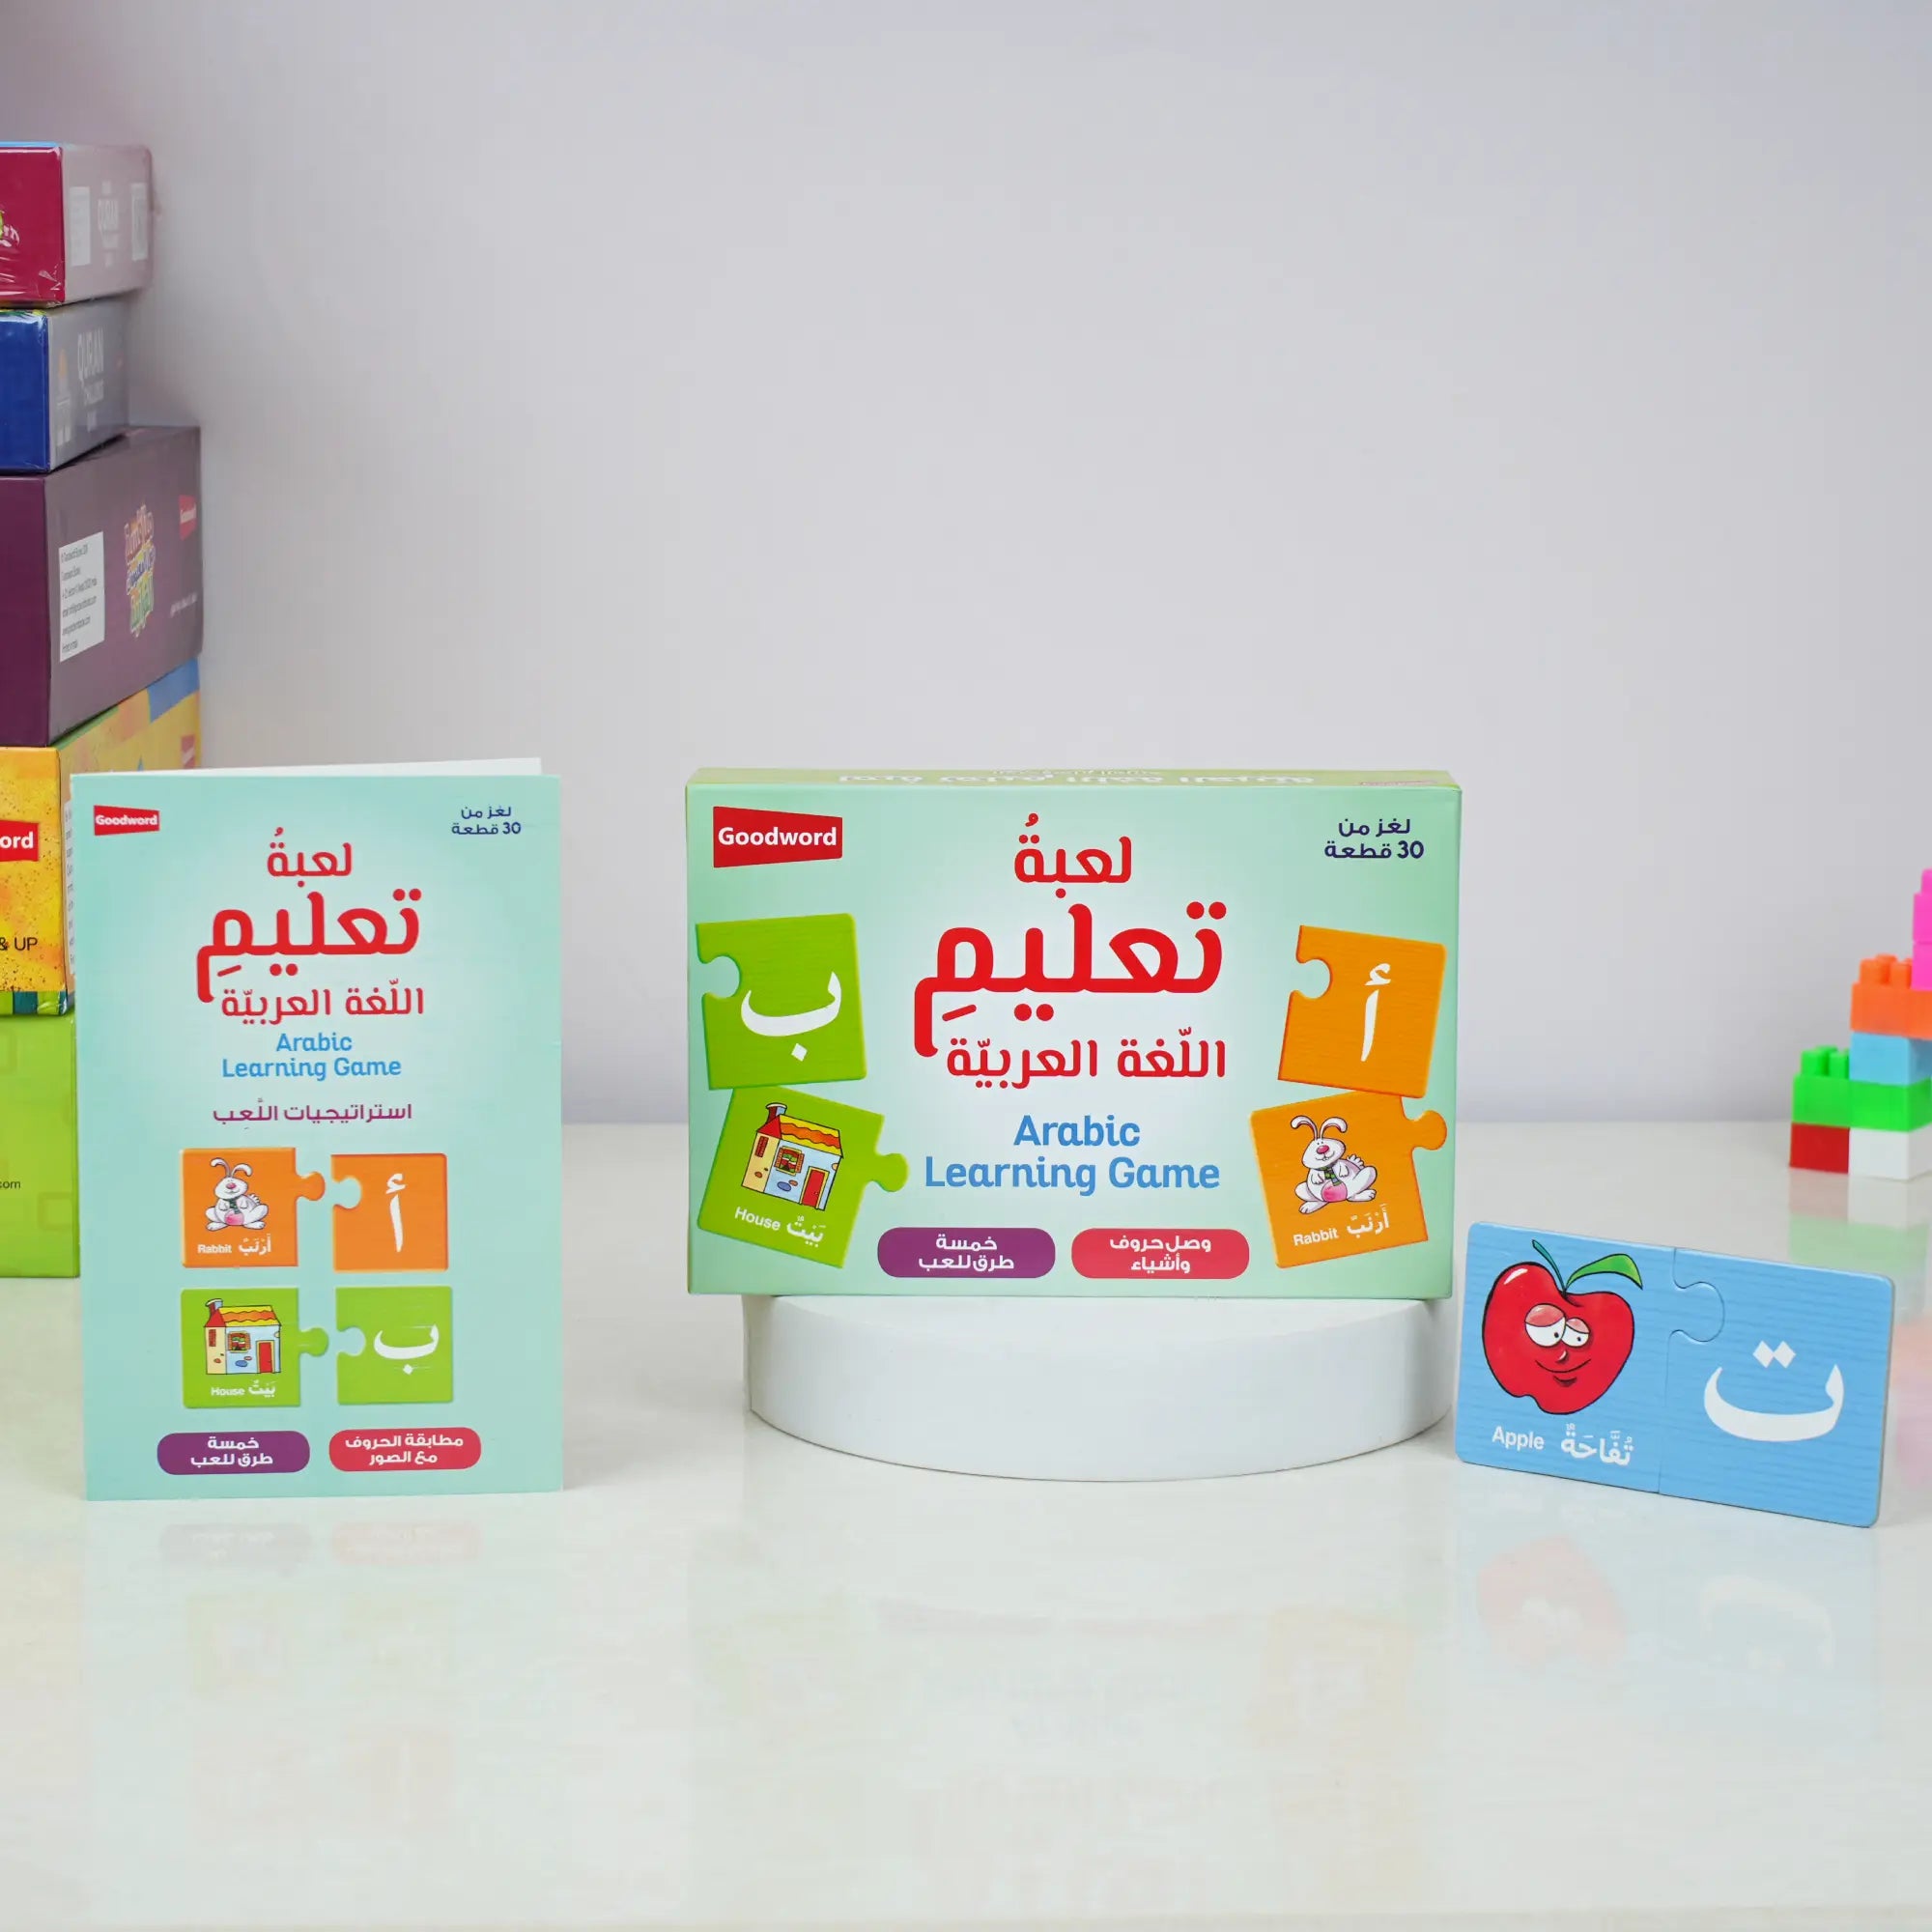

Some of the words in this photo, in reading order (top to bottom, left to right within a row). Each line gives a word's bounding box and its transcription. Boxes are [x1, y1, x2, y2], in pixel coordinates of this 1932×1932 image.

[95, 813, 158, 829] Goodword
[461, 806, 483, 819] من
[487, 805, 512, 819] لغز
[451, 822, 499, 835] قطعة
[502, 821, 522, 835] 30
[1338, 817, 1370, 838] من
[1377, 817, 1411, 838] لغز
[717, 826, 838, 850] Goodword
[1323, 838, 1392, 860] قطعة
[1397, 839, 1425, 860] 30
[14, 936, 39, 952] UP
[740, 970, 842, 1062] ب
[1359, 962, 1391, 1063] أ
[275, 1032, 353, 1053] Arabic
[221, 1057, 327, 1082] Learning
[333, 1058, 402, 1077] Game
[283, 1103, 412, 1124] استراتيجيات
[1012, 1114, 1141, 1148] Arabic
[924, 1155, 1097, 1198] Learning
[1108, 1155, 1221, 1190] Game
[385, 1172, 407, 1253] أ
[734, 1206, 781, 1232] House
[935, 1233, 998, 1252] خمسة
[1110, 1234, 1163, 1253] حروف
[1164, 1235, 1212, 1253] وصل
[1293, 1227, 1339, 1246] Rabbit
[197, 1243, 233, 1254] Rabbit
[919, 1254, 972, 1272] للعب
[972, 1254, 1014, 1272] طرق
[1130, 1253, 1191, 1273] وأشياء
[373, 1323, 440, 1375] ب
[210, 1386, 245, 1397] House
[1703, 1340, 1845, 1442] ت
[207, 1435, 259, 1450] خمسة
[345, 1435, 403, 1450] الحروف
[404, 1433, 465, 1448] مطابقة
[1492, 1425, 1546, 1452] Apple
[190, 1452, 235, 1468] للعب
[238, 1452, 273, 1467] طرق
[369, 1450, 412, 1466] الصور
[414, 1450, 439, 1465] مع
